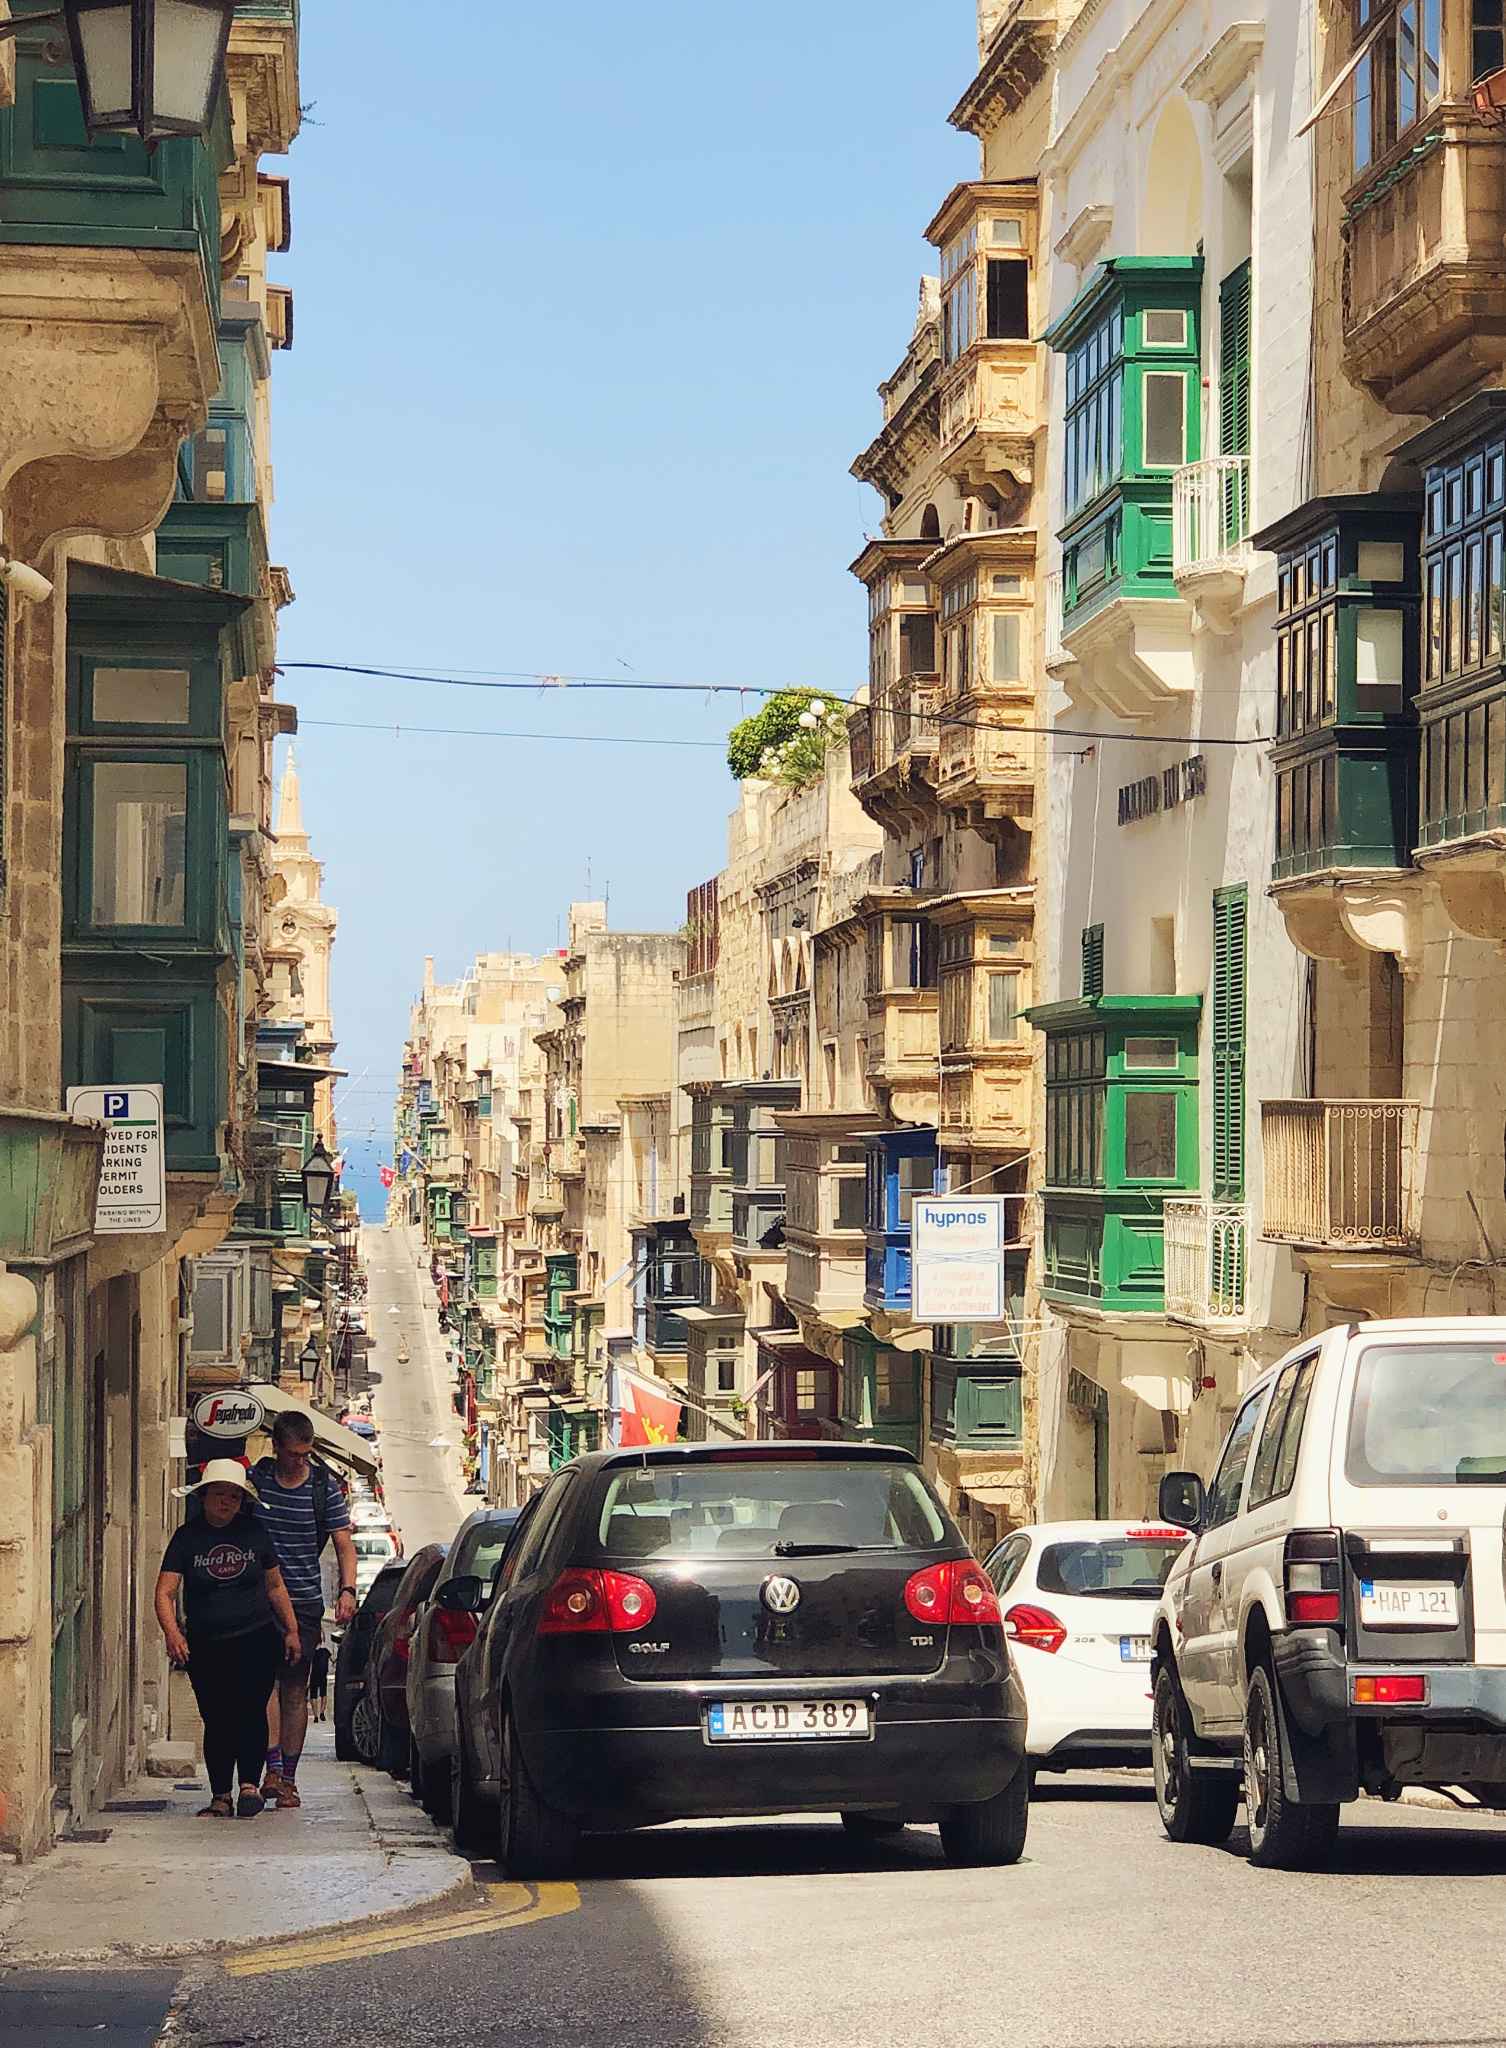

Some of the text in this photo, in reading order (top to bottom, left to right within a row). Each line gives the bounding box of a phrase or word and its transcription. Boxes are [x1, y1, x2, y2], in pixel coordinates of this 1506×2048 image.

[108, 1096, 124, 1116] P
[136, 1130, 158, 1140] FOR
[99, 1184, 143, 1195] OLDERS
[925, 1208, 987, 1228] hypnos
[203, 1399, 256, 1427] Segafredo
[193, 1549, 256, 1568] Hard Rock
[1379, 1591, 1451, 1613] HAP 121
[628, 1642, 670, 1654] GOLF
[910, 1635, 933, 1646] TDI
[732, 1702, 857, 1730] ACD 389
